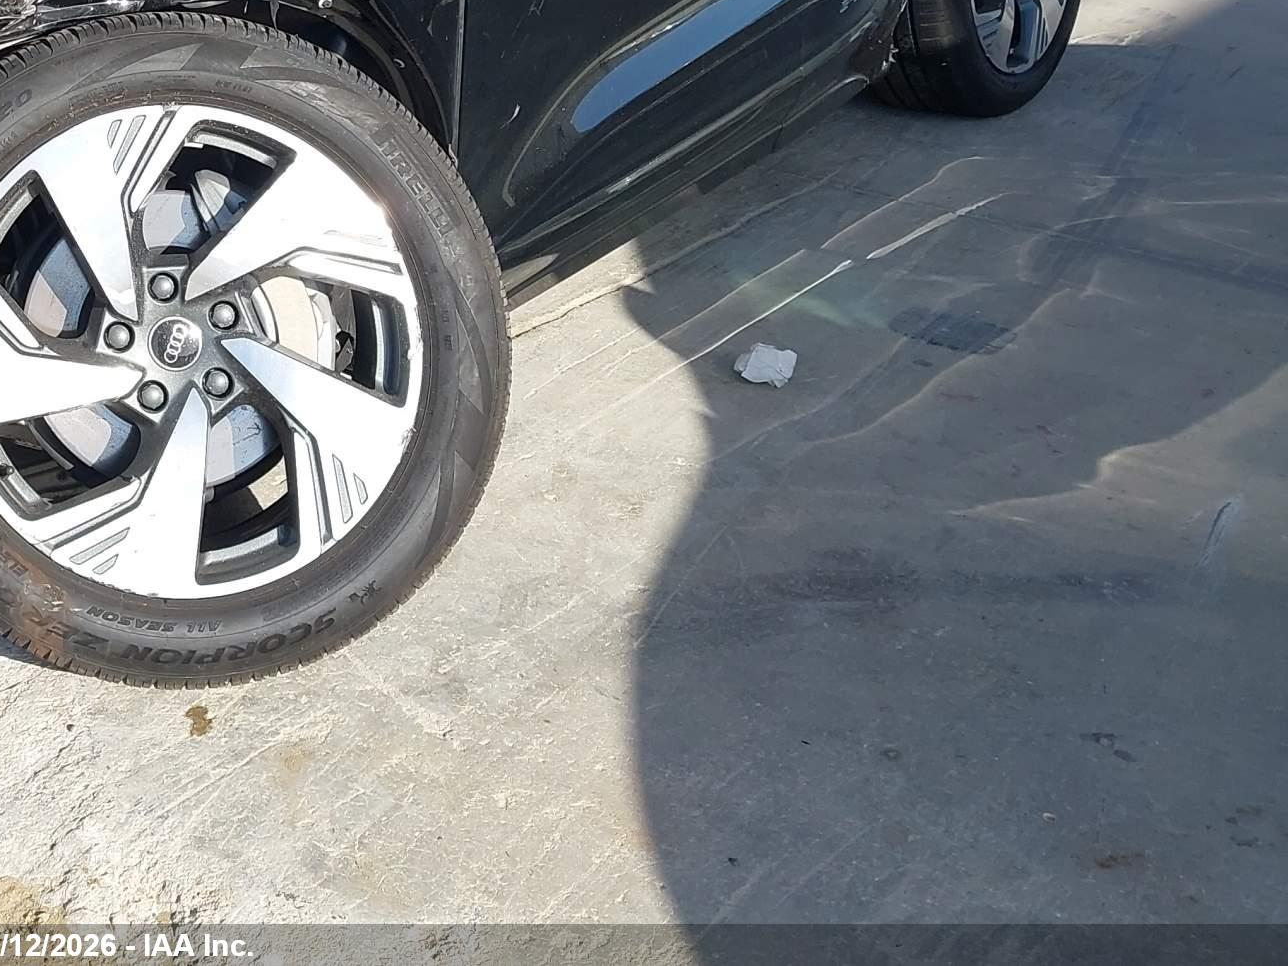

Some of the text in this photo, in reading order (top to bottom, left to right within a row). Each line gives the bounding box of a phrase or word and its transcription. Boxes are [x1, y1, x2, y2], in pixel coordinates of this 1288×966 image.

[369, 123, 454, 237] IRELLI
[86, 605, 222, 633] ALL SEASON
[120, 607, 338, 665] SCORPION
